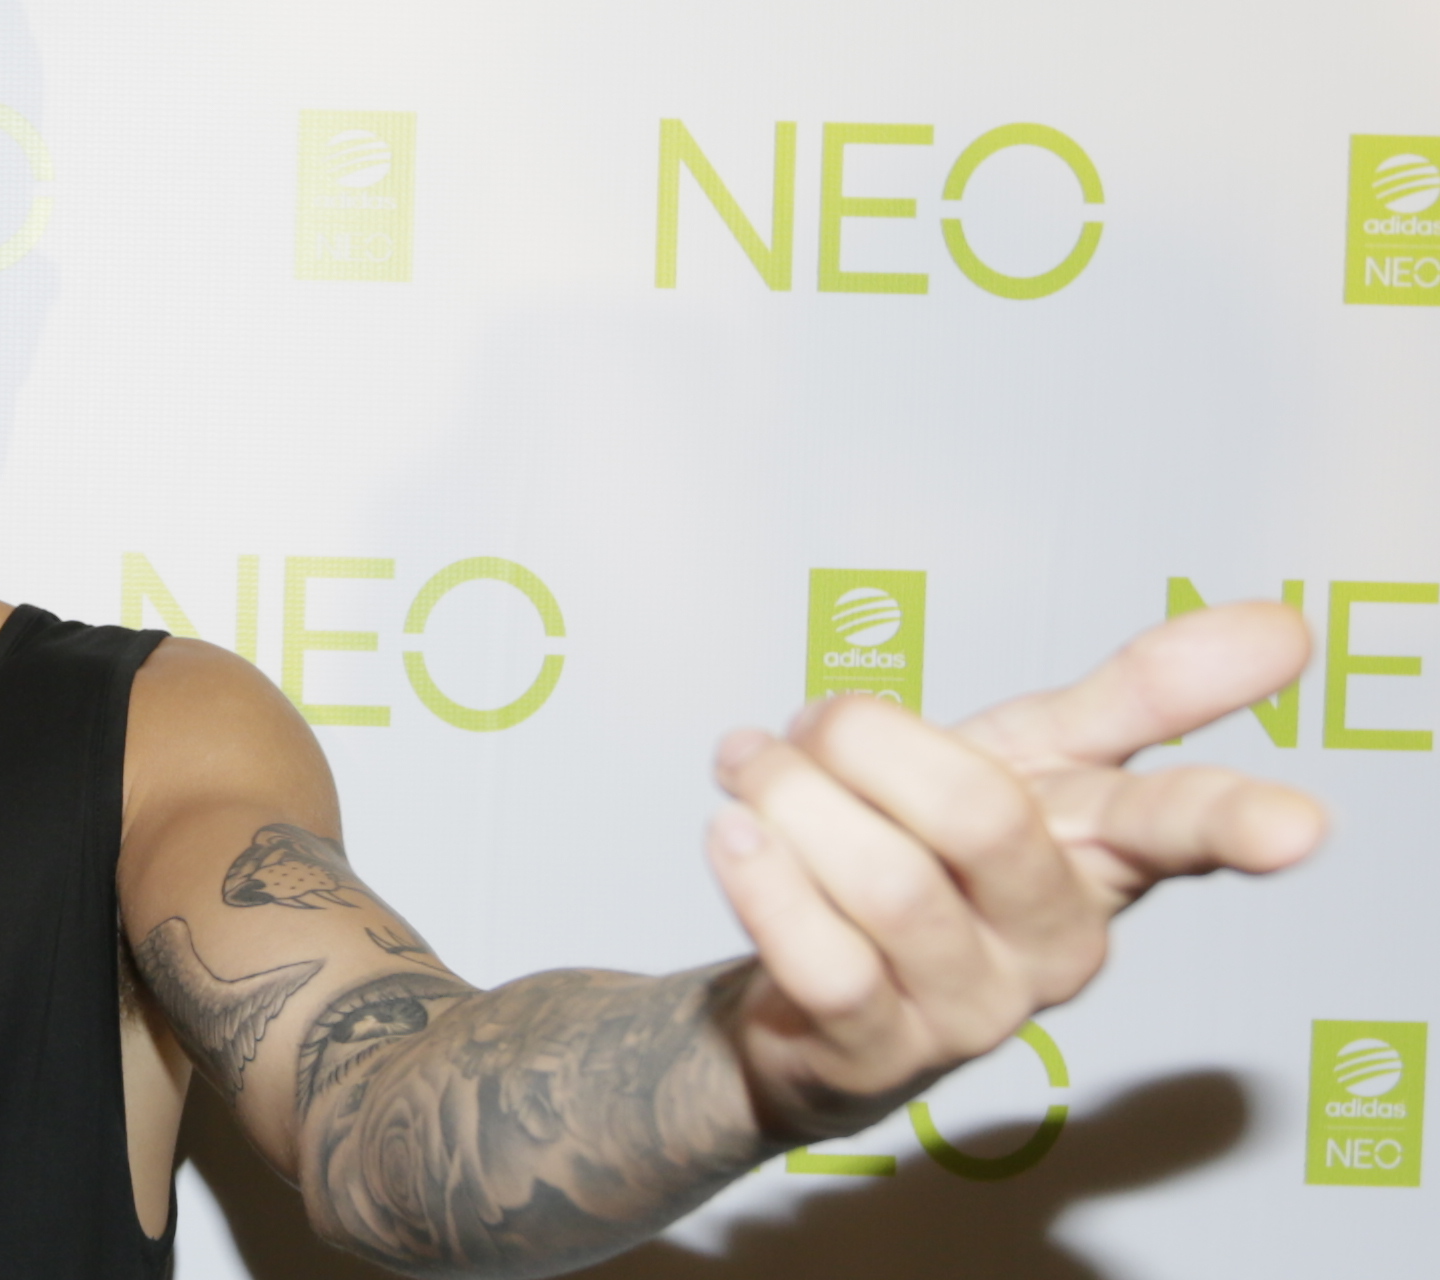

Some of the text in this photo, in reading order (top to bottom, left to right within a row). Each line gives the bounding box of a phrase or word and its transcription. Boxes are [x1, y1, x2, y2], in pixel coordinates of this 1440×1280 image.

[657, 119, 1104, 300] NEO
[823, 647, 908, 669] adidas
[1325, 1098, 1407, 1119] adidas
[1326, 1137, 1403, 1170] NEO
